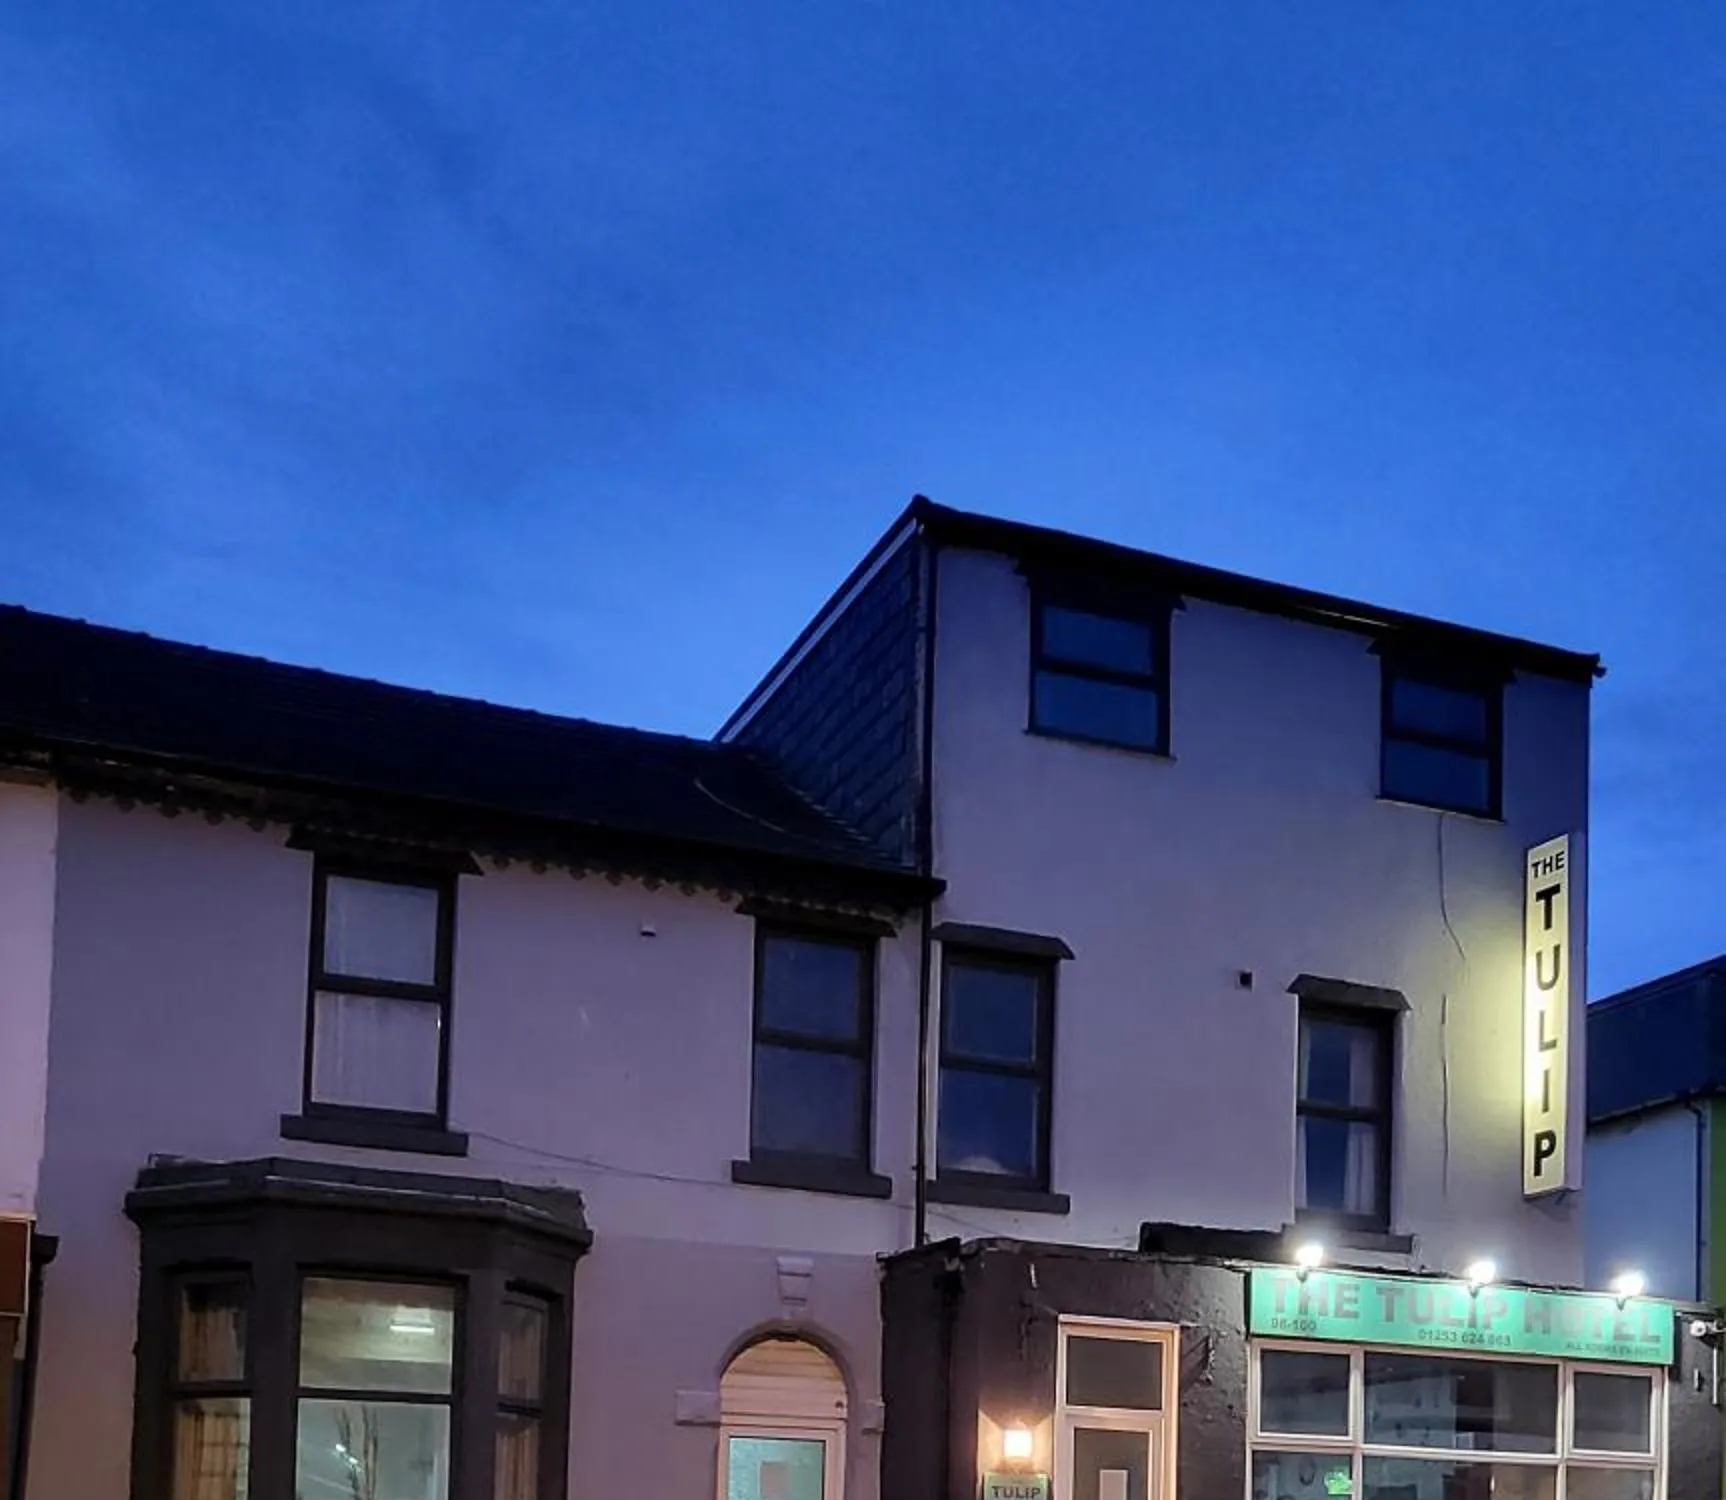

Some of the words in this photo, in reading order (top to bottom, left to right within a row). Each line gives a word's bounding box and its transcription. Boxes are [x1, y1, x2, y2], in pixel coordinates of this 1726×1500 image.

[1531, 851, 1565, 879] THE
[1533, 883, 1562, 1178] TULIP
[1272, 1278, 1360, 1318] THE
[1375, 1286, 1508, 1328] TULIP
[1523, 1297, 1661, 1343] HOTEL
[991, 1485, 1041, 1500] TULIP
